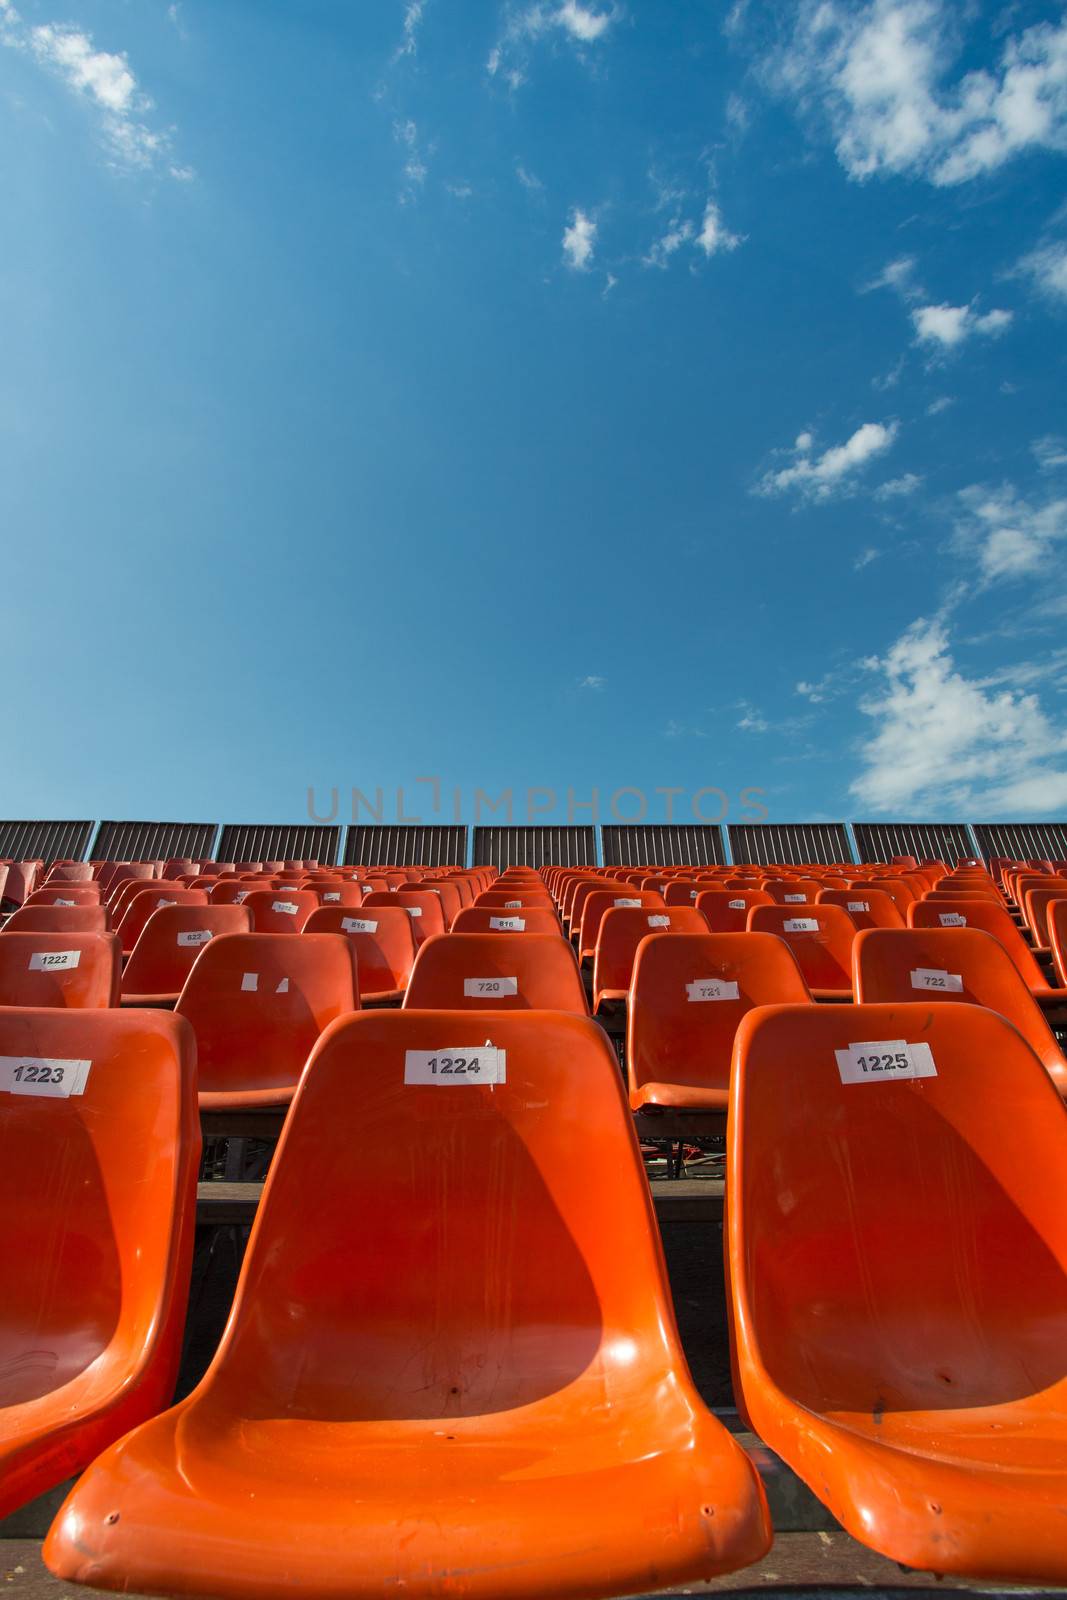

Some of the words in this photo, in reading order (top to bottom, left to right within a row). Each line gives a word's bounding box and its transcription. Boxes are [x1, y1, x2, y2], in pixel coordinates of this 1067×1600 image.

[41, 955, 68, 965] 1222
[477, 981, 499, 991] 720
[924, 976, 946, 987] 722
[427, 1058, 481, 1074] 1224
[857, 1053, 908, 1072] 1225
[13, 1066, 65, 1083] 1223
